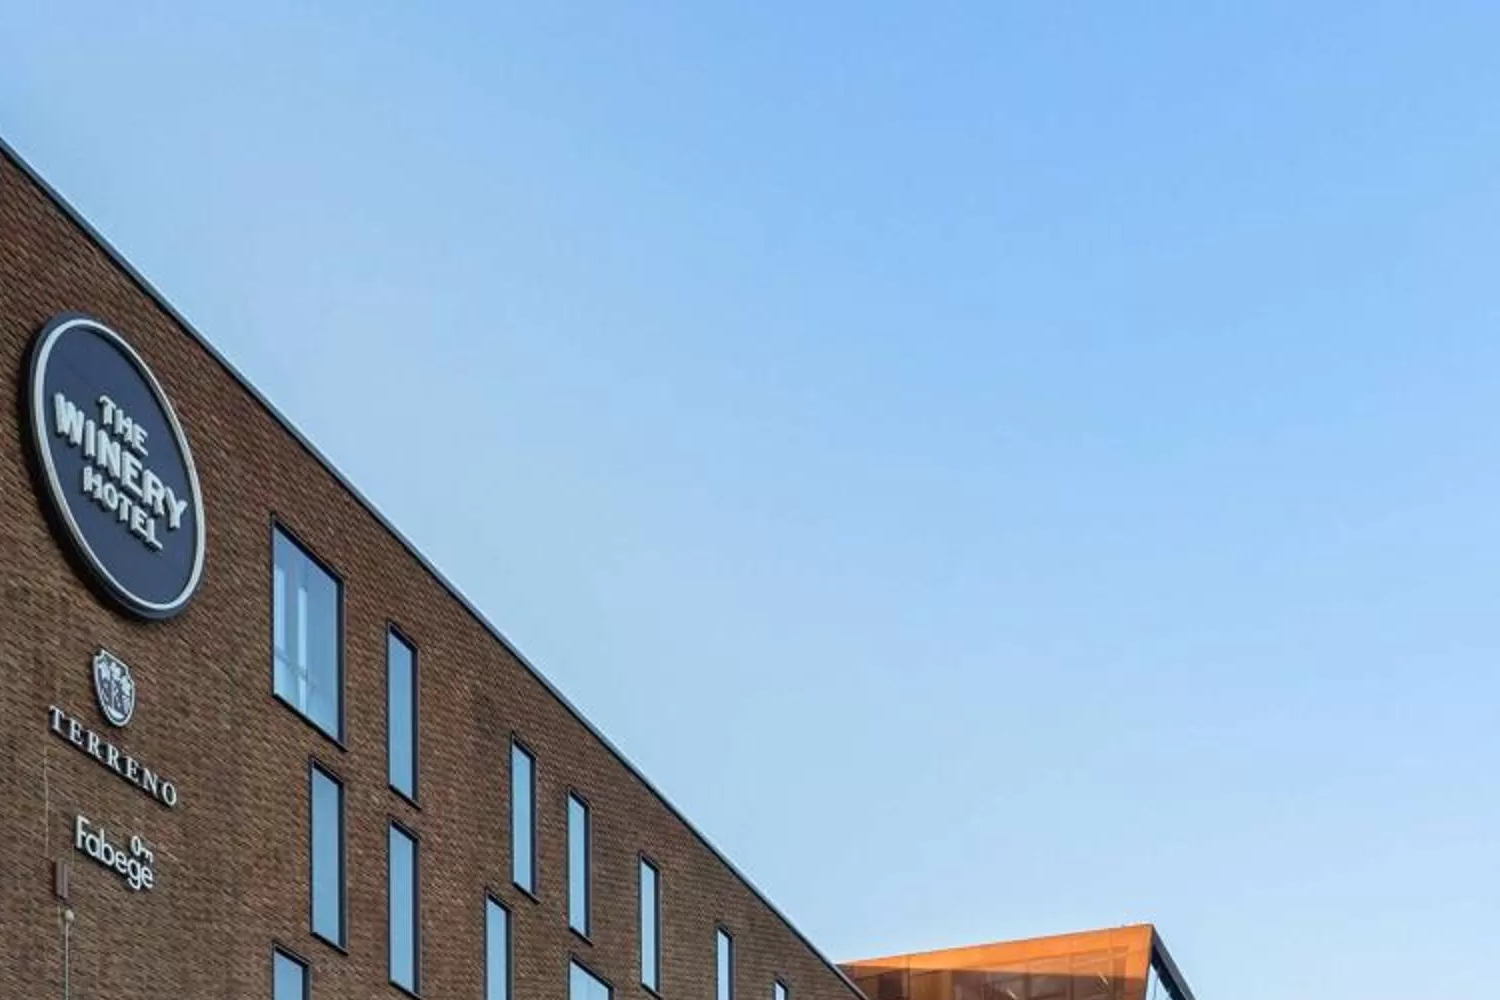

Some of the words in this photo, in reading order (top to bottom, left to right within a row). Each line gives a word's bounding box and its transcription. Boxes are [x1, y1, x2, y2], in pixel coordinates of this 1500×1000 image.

[53, 392, 187, 529] WINERY
[98, 394, 148, 456] THE
[83, 465, 163, 550] HOTEL
[49, 704, 177, 807] TERRENO
[75, 814, 154, 891] Fabege
